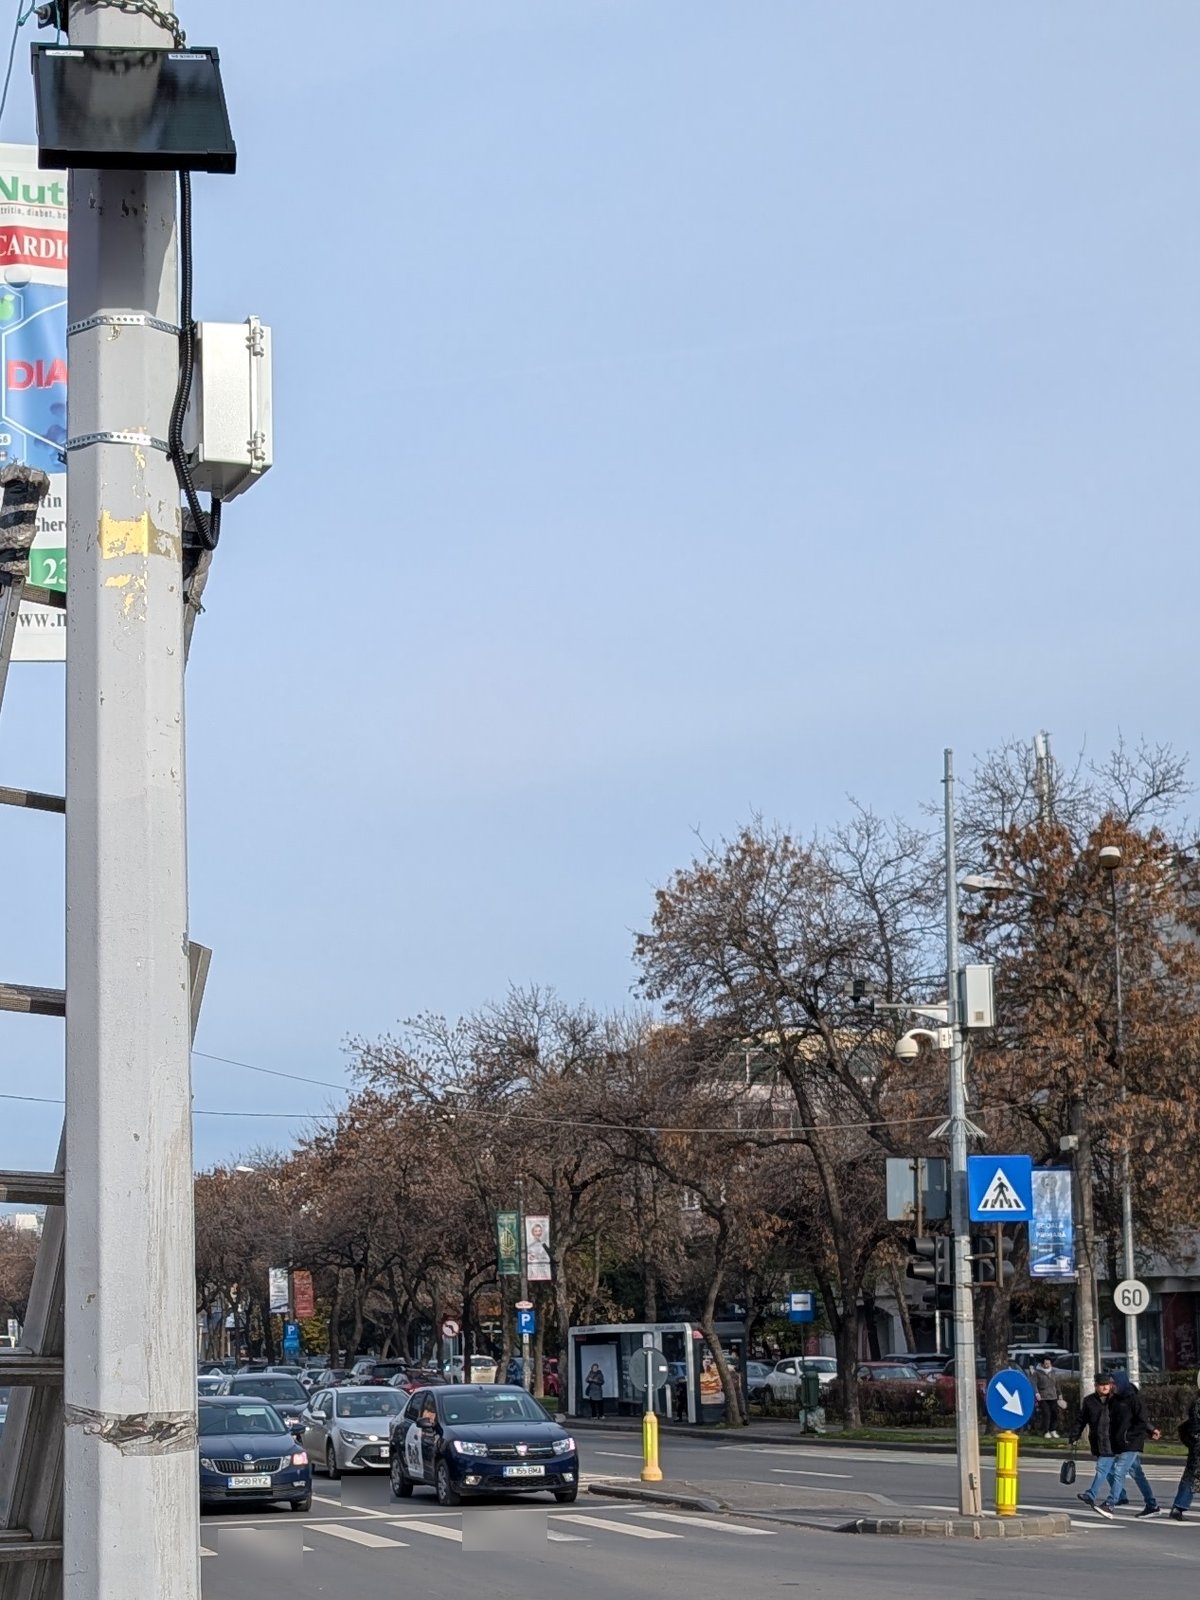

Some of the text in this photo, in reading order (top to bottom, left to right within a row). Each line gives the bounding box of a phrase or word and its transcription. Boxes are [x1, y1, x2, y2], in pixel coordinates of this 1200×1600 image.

[1122, 1289, 1142, 1306] 60
[521, 1313, 531, 1326] P
[287, 1325, 295, 1335] P
